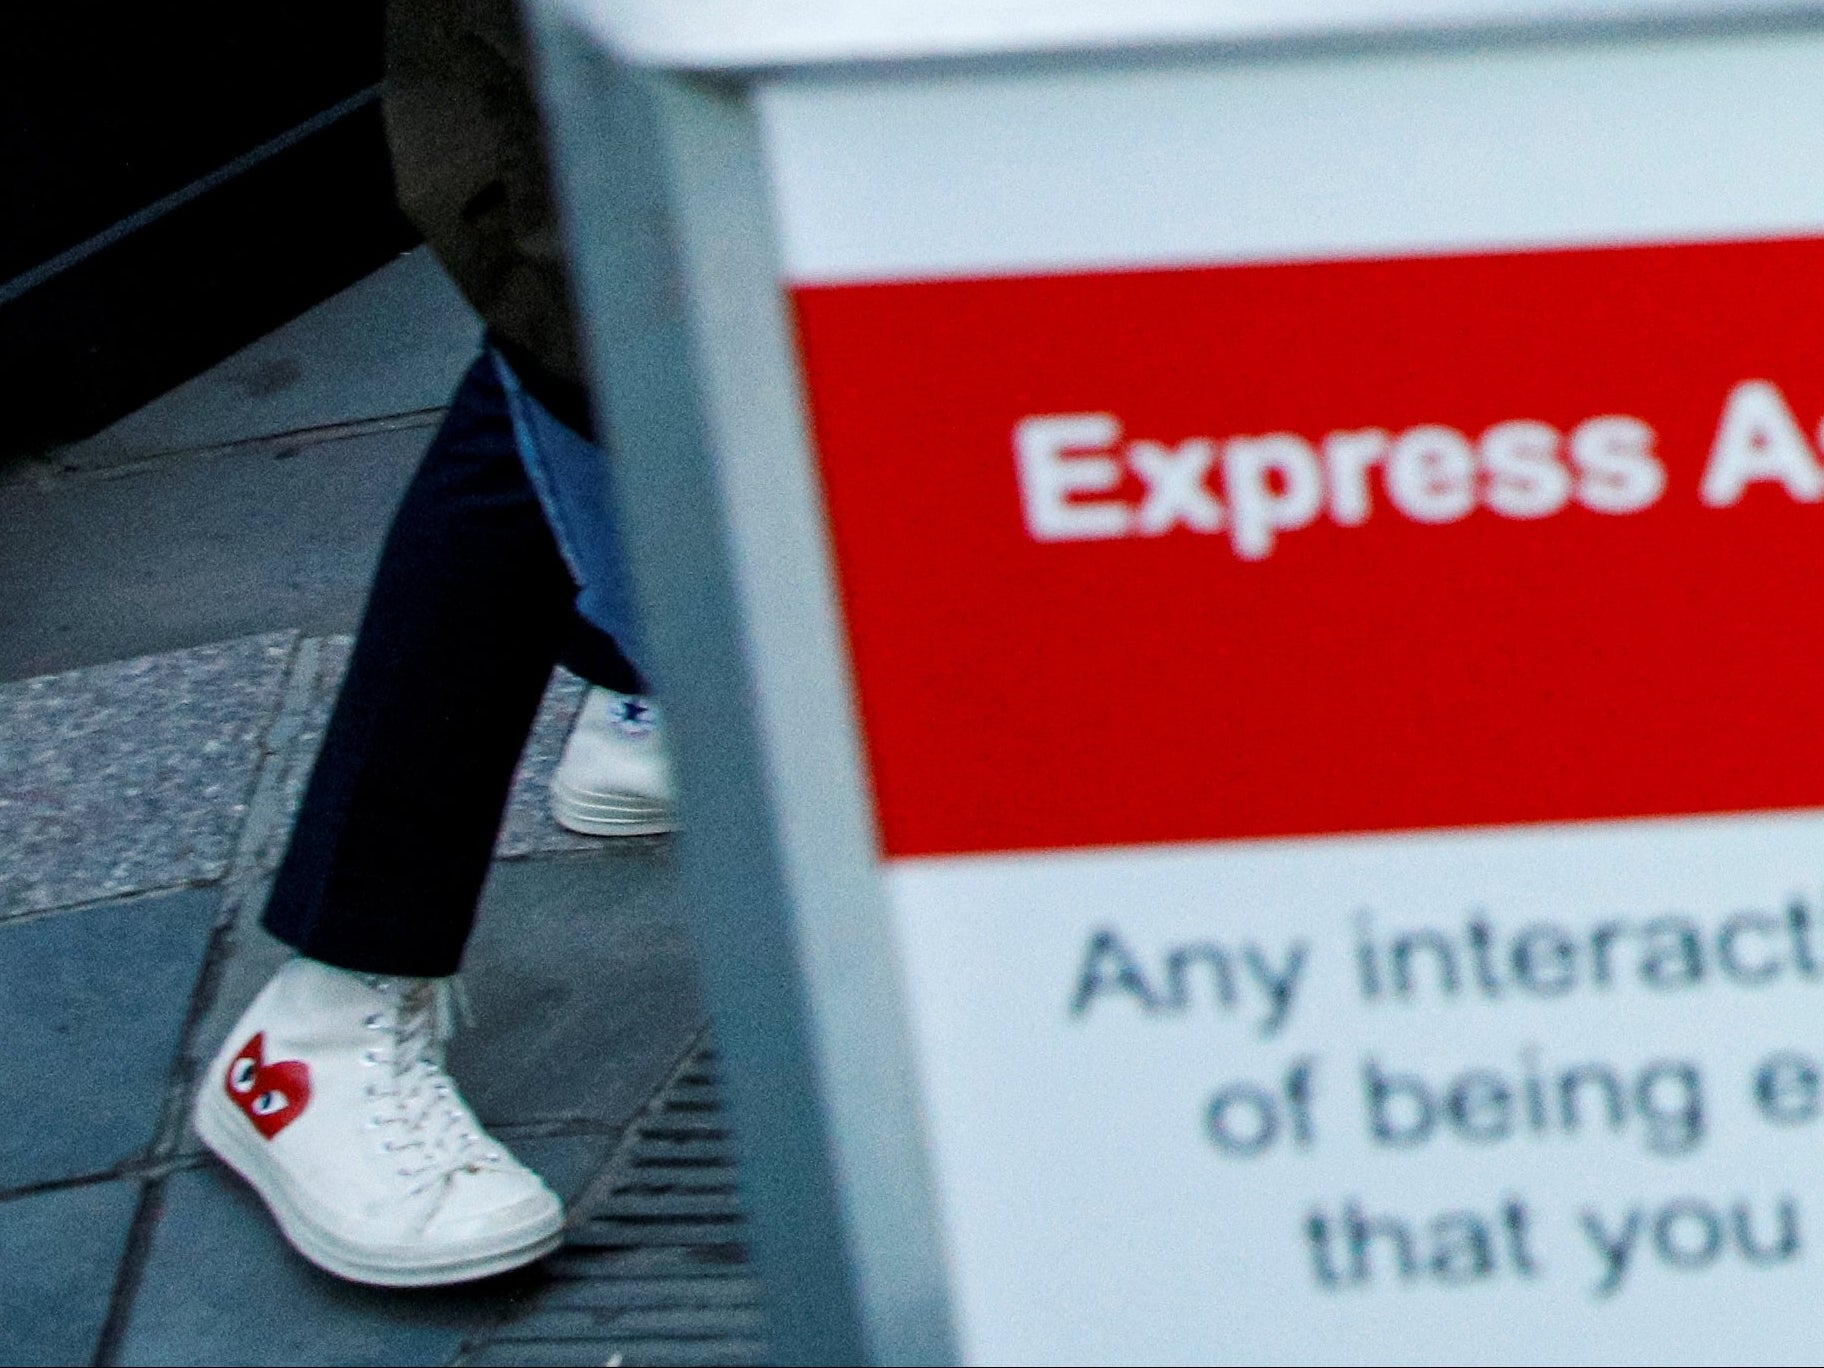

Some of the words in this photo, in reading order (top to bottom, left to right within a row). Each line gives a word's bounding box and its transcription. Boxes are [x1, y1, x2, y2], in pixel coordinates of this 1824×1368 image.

[1014, 413, 1666, 560] Express
[1067, 922, 1308, 1038] Any
[1200, 1054, 1317, 1159] of
[1359, 1046, 1708, 1157] being
[1300, 1196, 1537, 1290] that
[1580, 1194, 1802, 1297] you
